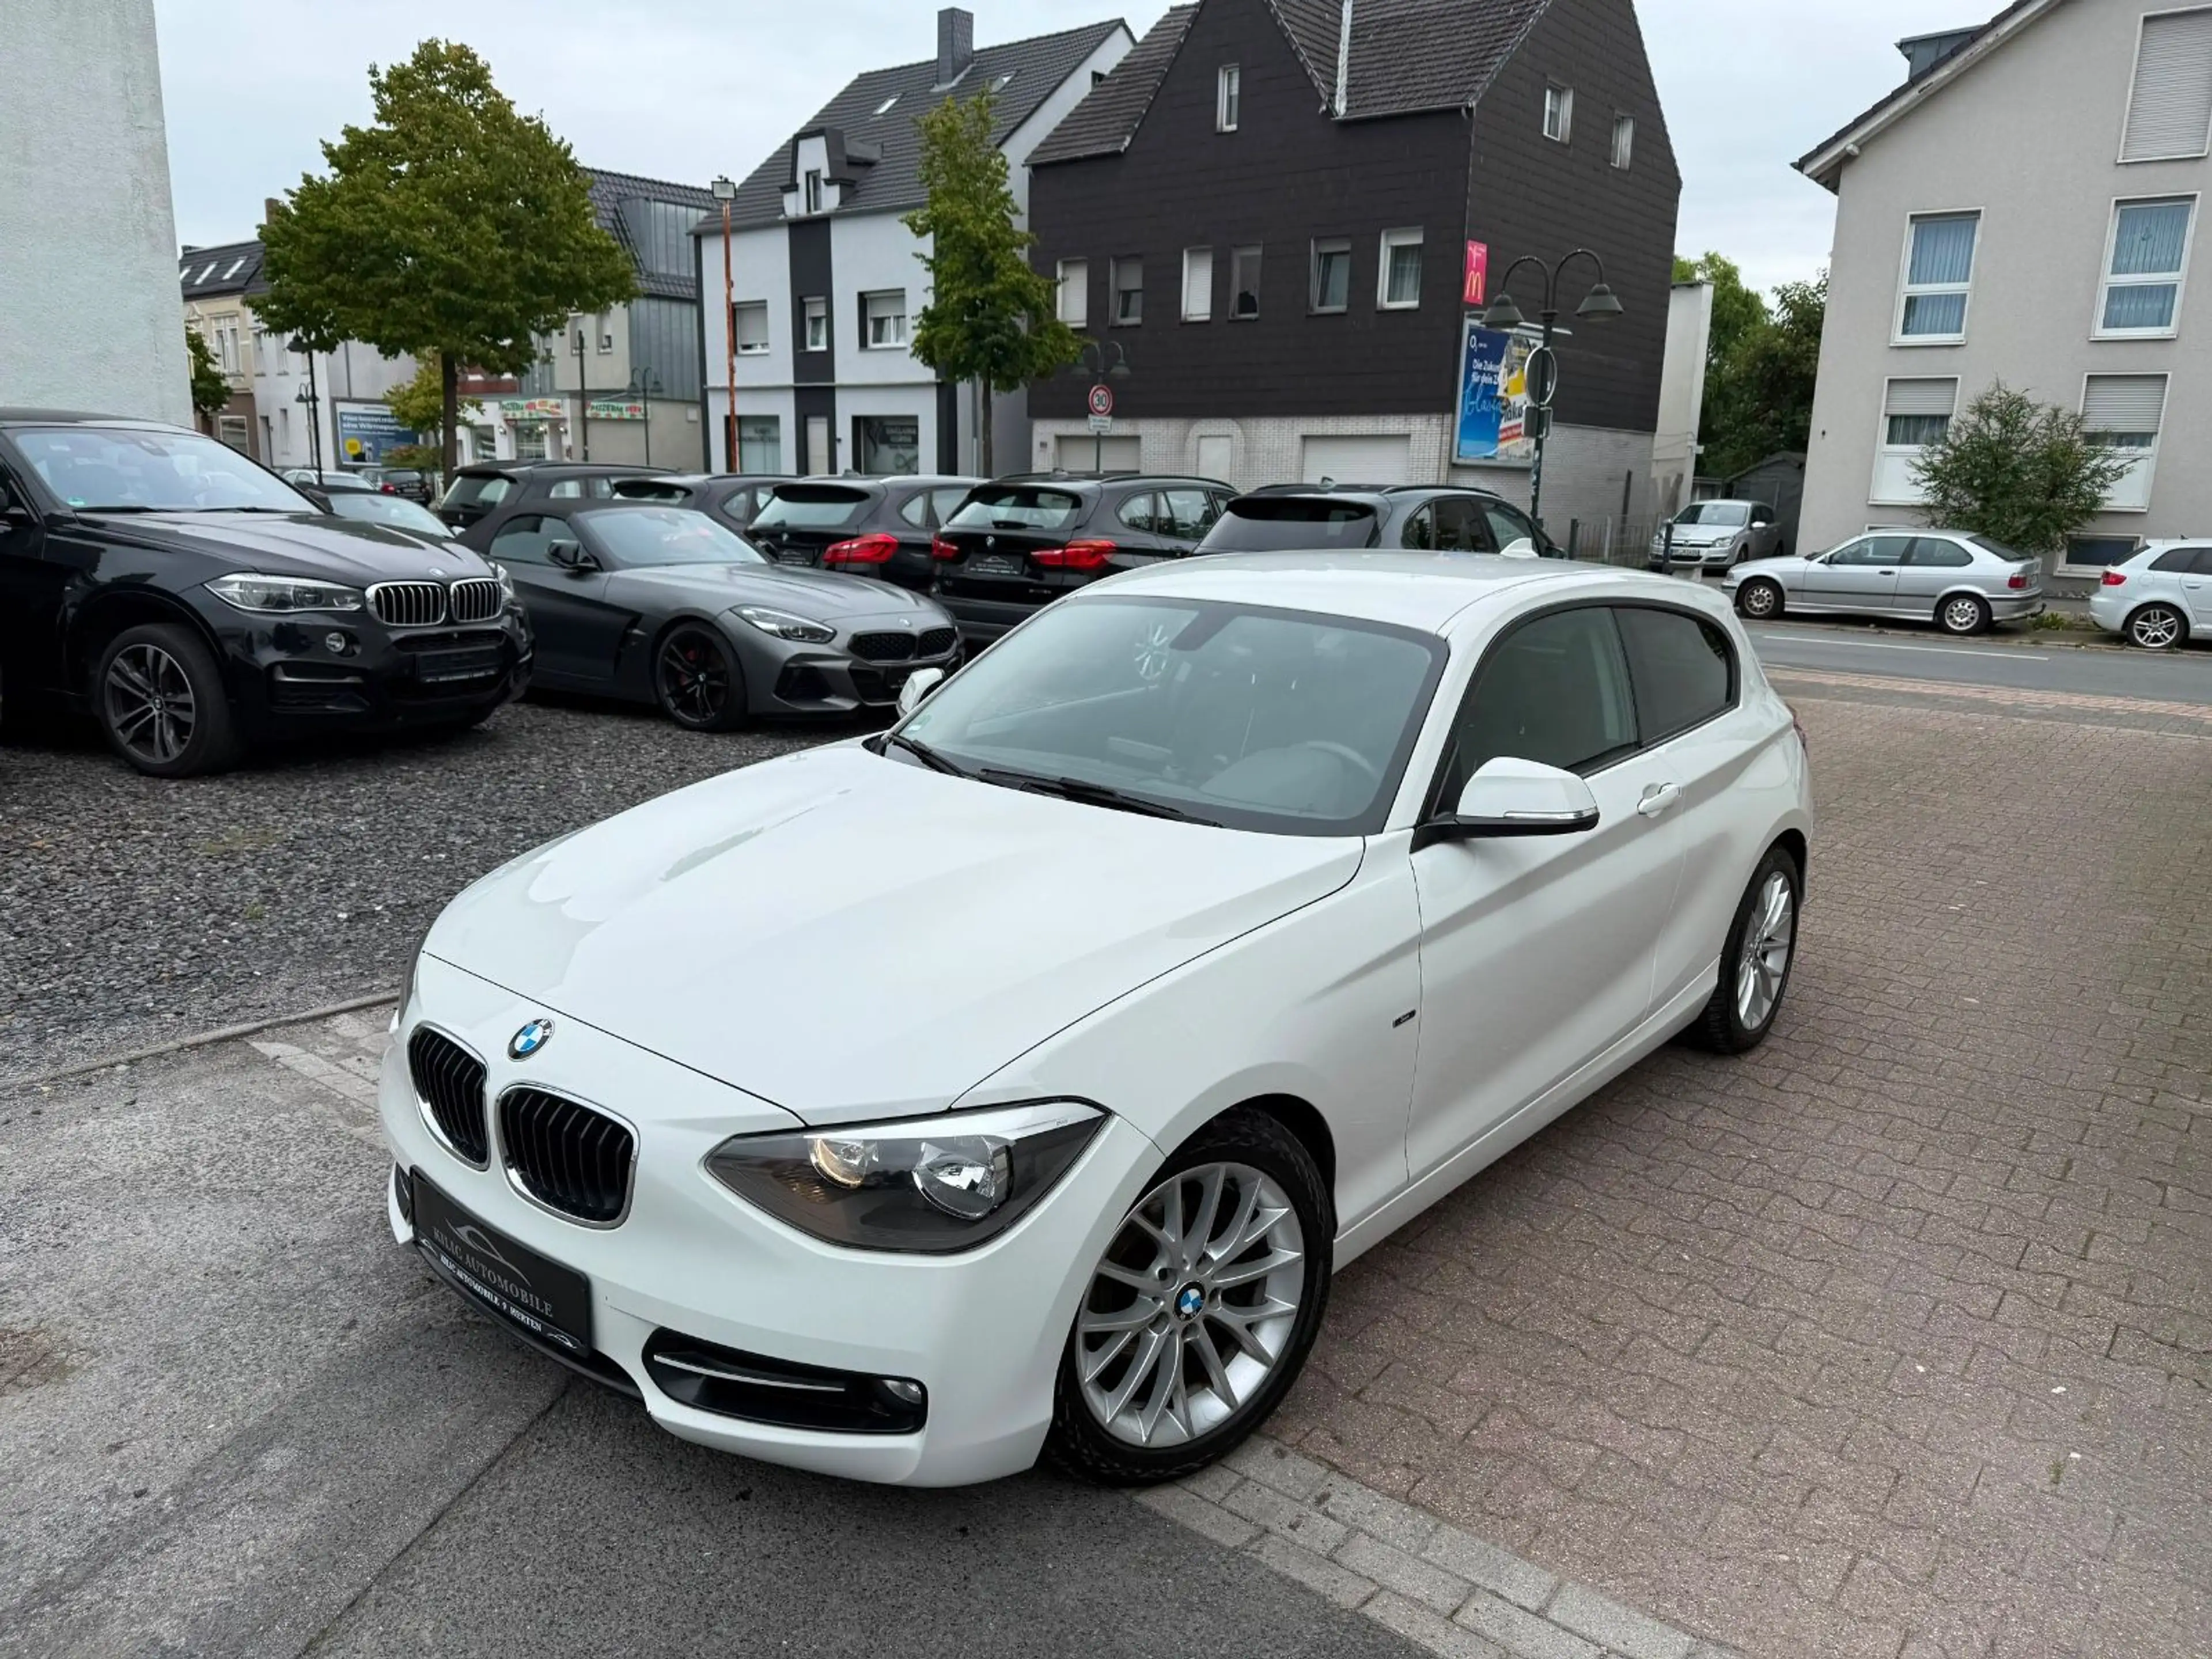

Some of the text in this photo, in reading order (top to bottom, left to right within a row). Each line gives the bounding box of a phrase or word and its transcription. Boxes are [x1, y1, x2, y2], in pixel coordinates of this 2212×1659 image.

[1095, 393, 1107, 407] 30
[433, 1226, 553, 1318] KILIC AUTOMOBILE
[456, 1268, 500, 1306] AUTOMOBILE
